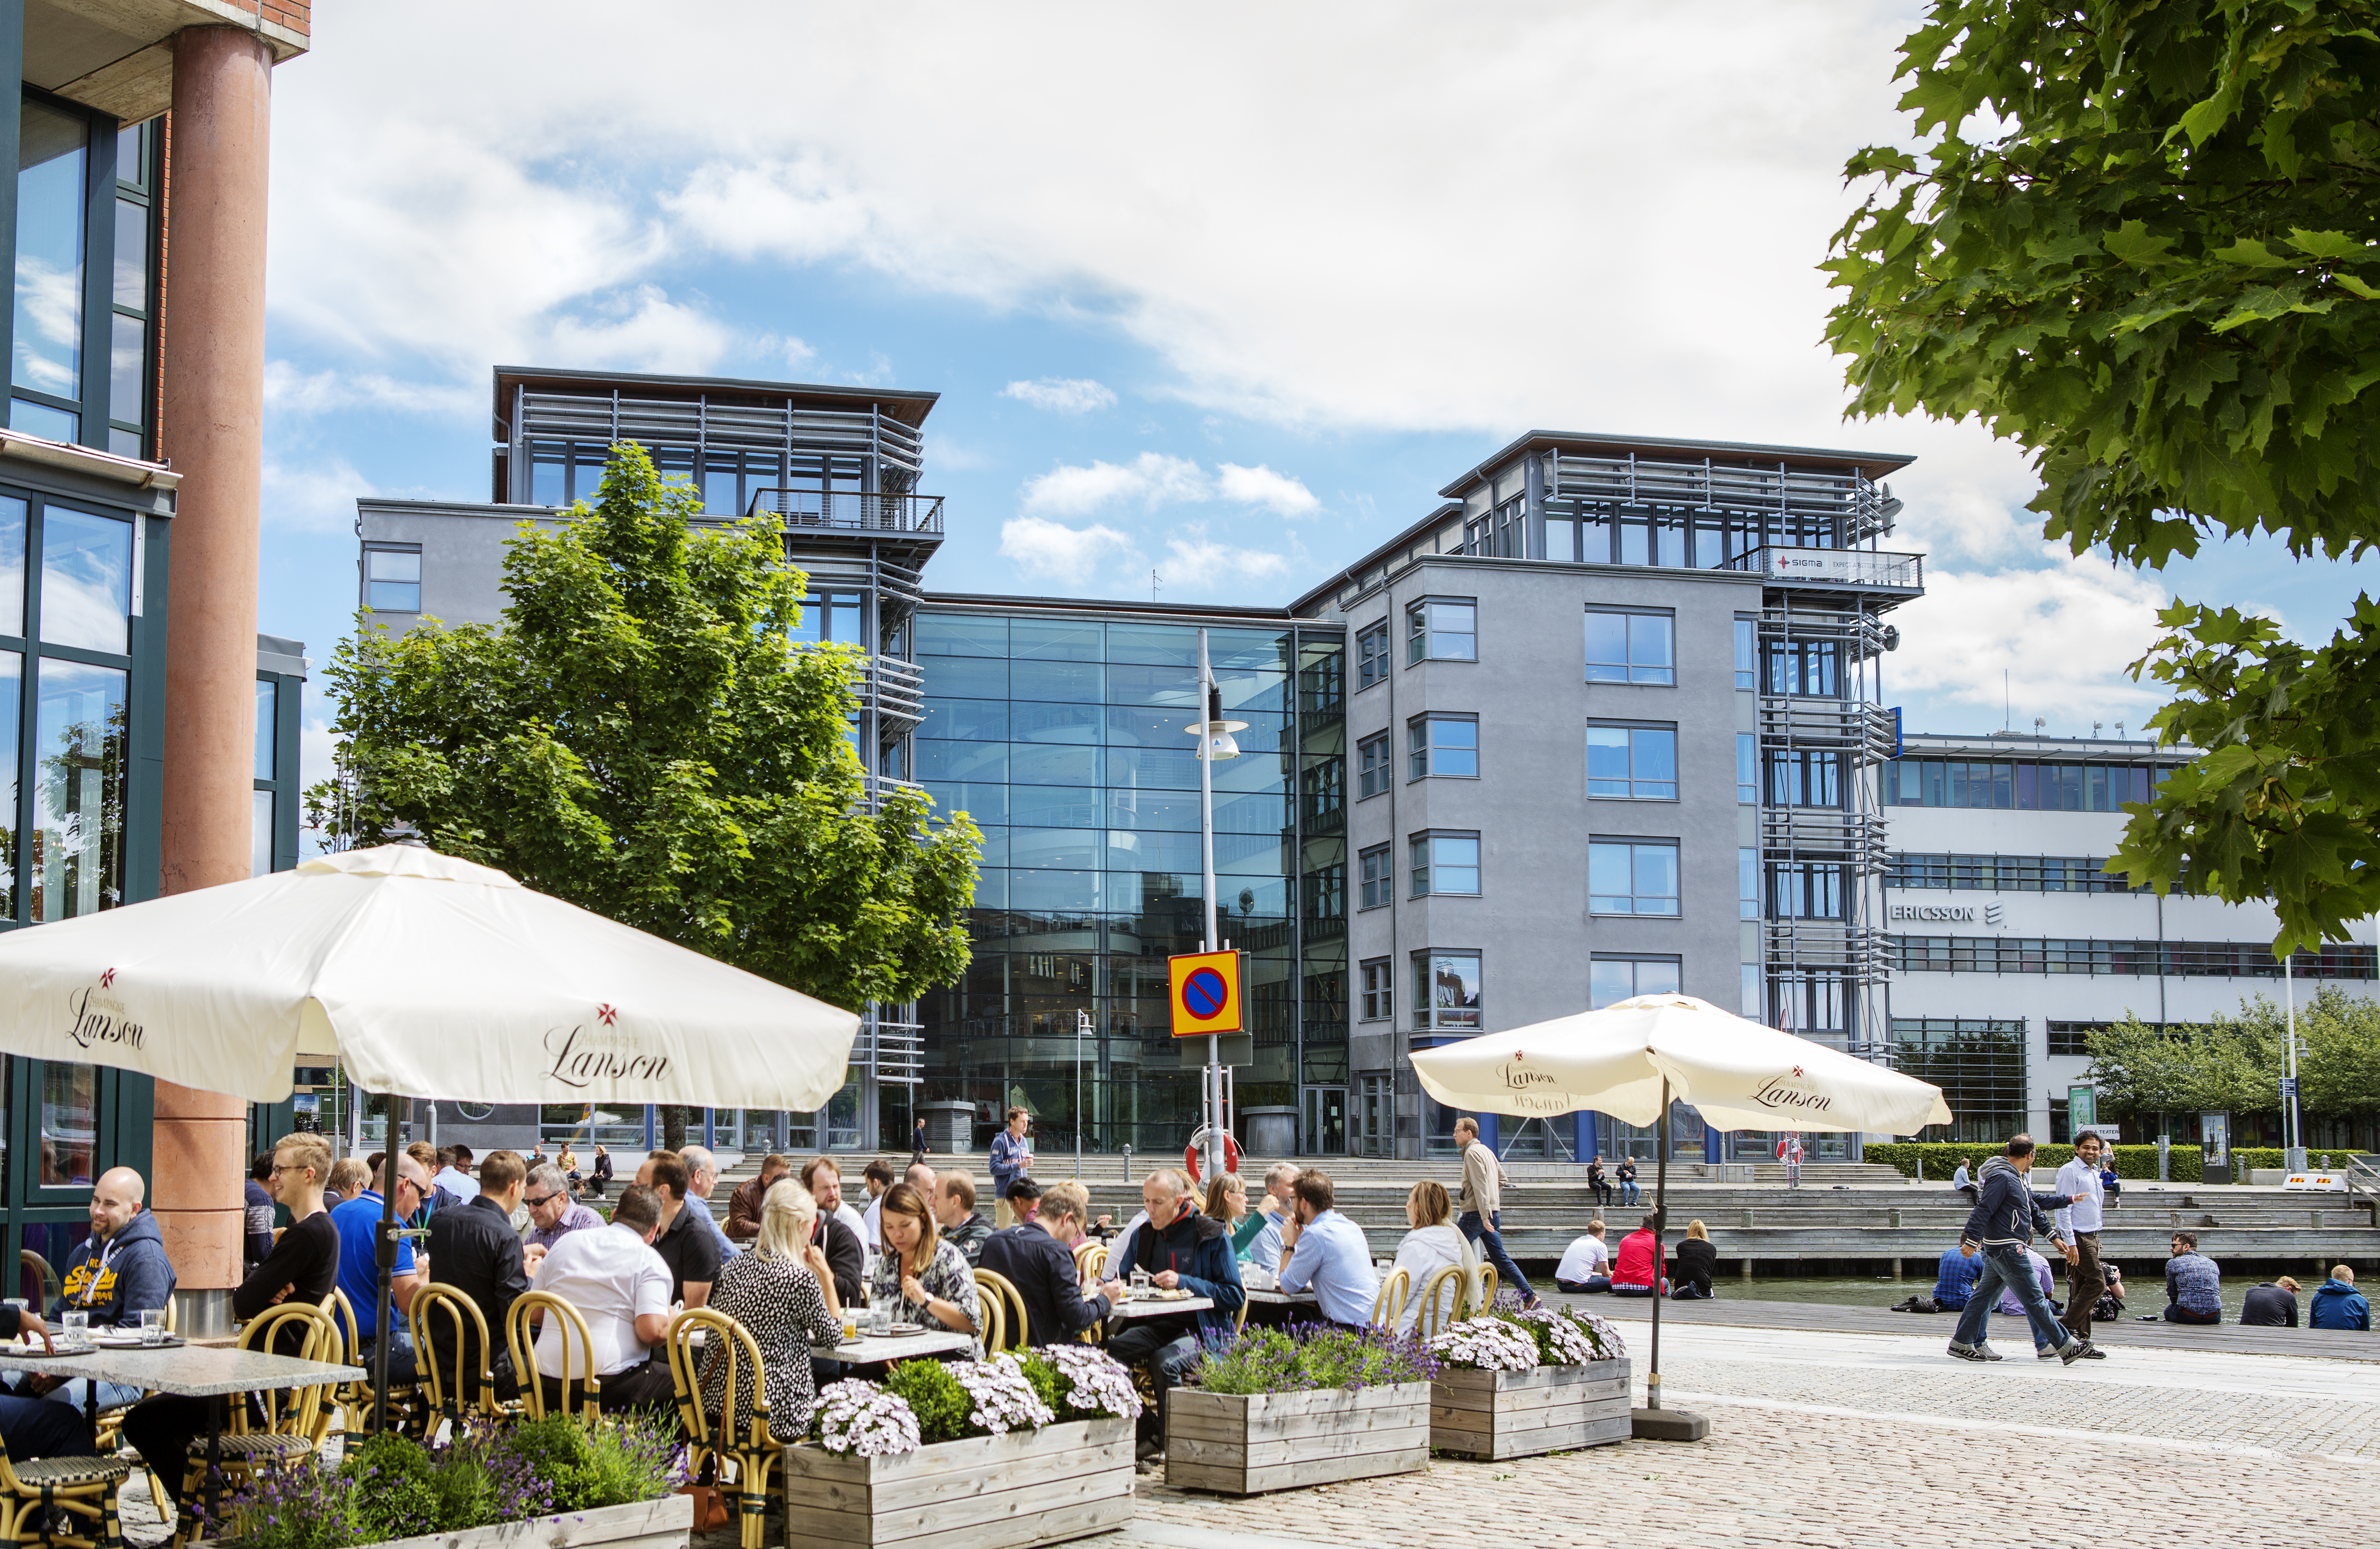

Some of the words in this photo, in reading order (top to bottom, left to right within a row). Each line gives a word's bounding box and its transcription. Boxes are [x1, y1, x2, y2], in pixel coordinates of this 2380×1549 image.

[1891, 905, 1976, 921] ERICSSON
[64, 986, 148, 1051] Lanson
[538, 1024, 673, 1087] Lanson
[1496, 1063, 1558, 1089] Lanson
[1776, 1079, 1816, 1092] CHAMPAGNE
[1747, 1075, 1834, 1111] Lanson
